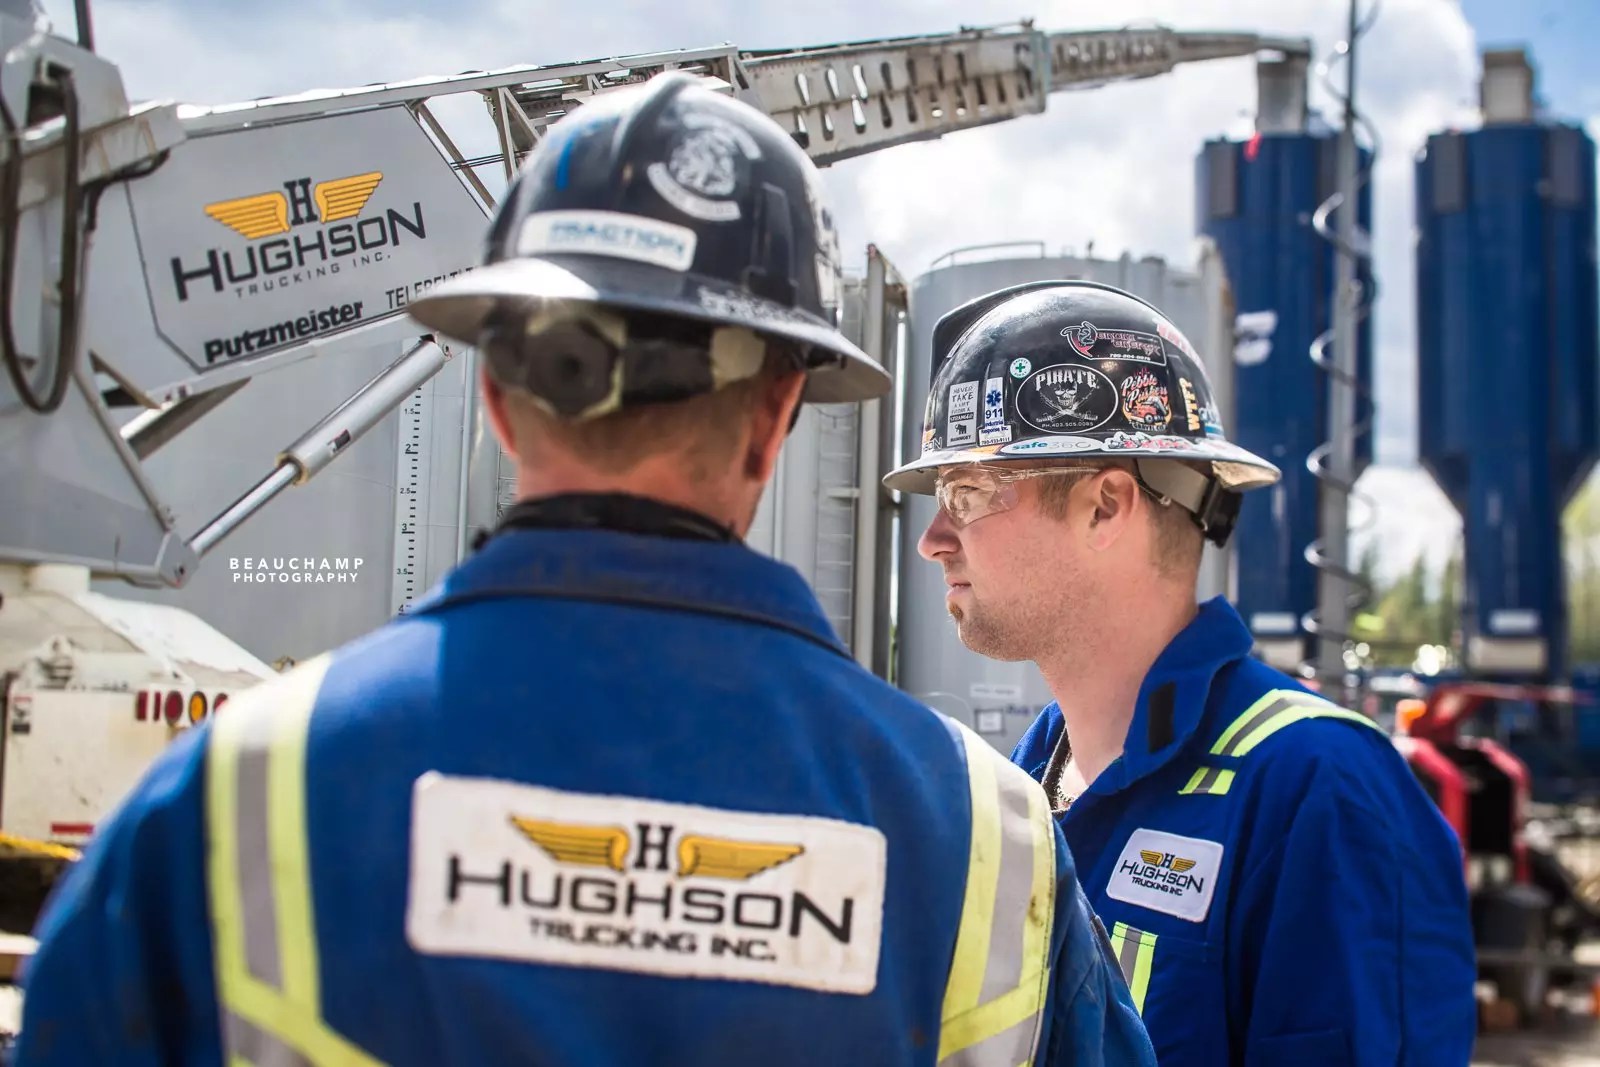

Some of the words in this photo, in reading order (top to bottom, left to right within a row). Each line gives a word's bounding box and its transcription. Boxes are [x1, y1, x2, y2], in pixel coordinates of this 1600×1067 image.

[284, 177, 318, 226] H
[170, 202, 427, 302] HUGHSON
[235, 263, 342, 298] TRUCKING
[352, 253, 392, 269] INC.
[204, 301, 364, 363] Putzmeister
[1035, 368, 1097, 392] PIRATE
[952, 391, 974, 403] TAKE
[985, 408, 1003, 419] 911
[405, 443, 412, 452] 2
[402, 523, 408, 531] 3
[398, 604, 404, 613] 4
[634, 822, 674, 870] H
[1161, 852, 1176, 869] H
[1119, 859, 1205, 894] HUGHSON
[1131, 876, 1169, 893] TRUCKING
[446, 854, 854, 944] HUGHSON
[530, 917, 697, 954] TRUCKING
[709, 935, 777, 962] INC.
